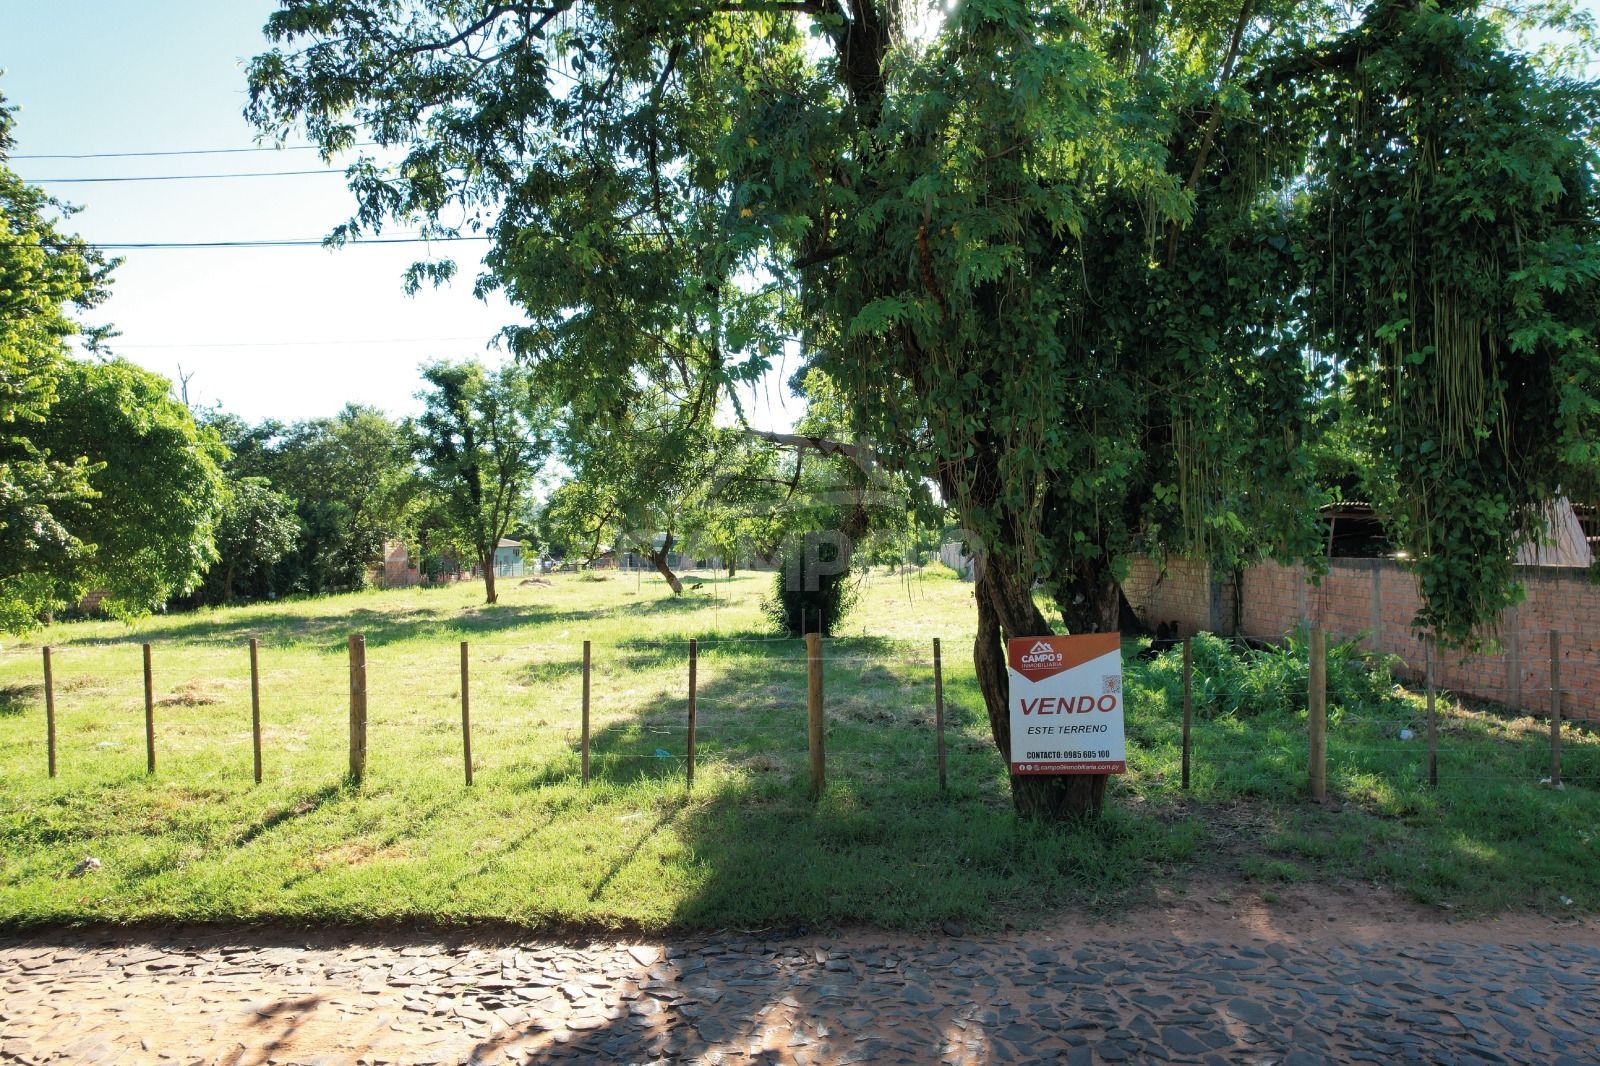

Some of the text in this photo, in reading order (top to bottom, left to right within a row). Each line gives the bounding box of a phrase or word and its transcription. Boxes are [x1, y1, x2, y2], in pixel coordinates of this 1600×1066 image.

[1021, 653, 1063, 663] CAMPO 9
[1020, 694, 1117, 716] VENDO
[1027, 724, 1108, 735] ESTE TERRENO
[1026, 750, 1110, 759] CONTACTO: 0985 605 100
